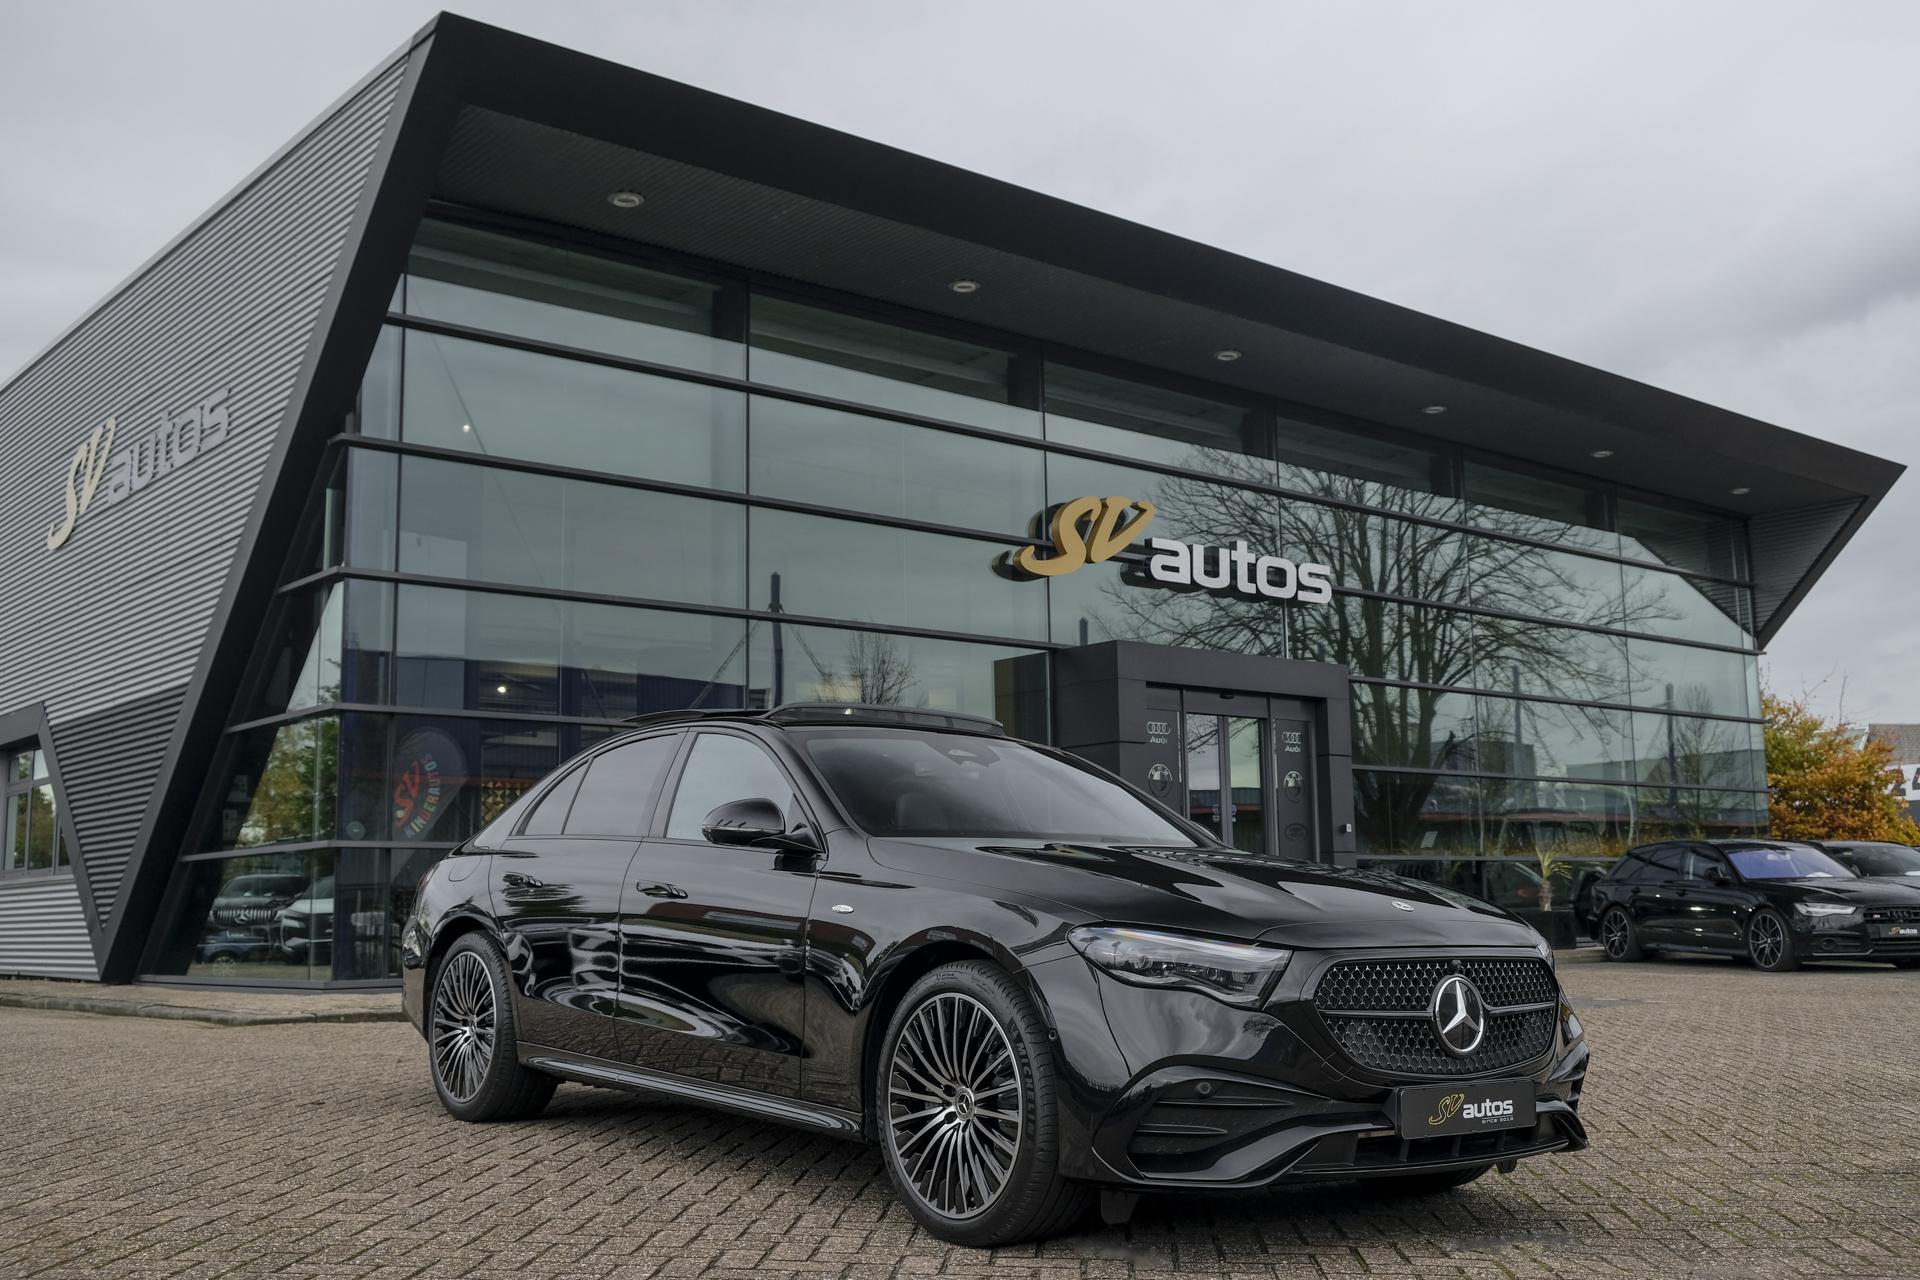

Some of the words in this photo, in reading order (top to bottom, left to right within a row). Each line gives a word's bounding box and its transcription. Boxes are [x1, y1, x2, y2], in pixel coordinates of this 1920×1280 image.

[107, 385, 232, 505] autos
[1013, 496, 1157, 577] SV
[1150, 537, 1333, 605] autos
[1016, 1042, 1036, 1141] MICHELIN
[1428, 1093, 1465, 1125] SV
[1463, 1099, 1514, 1119] autos
